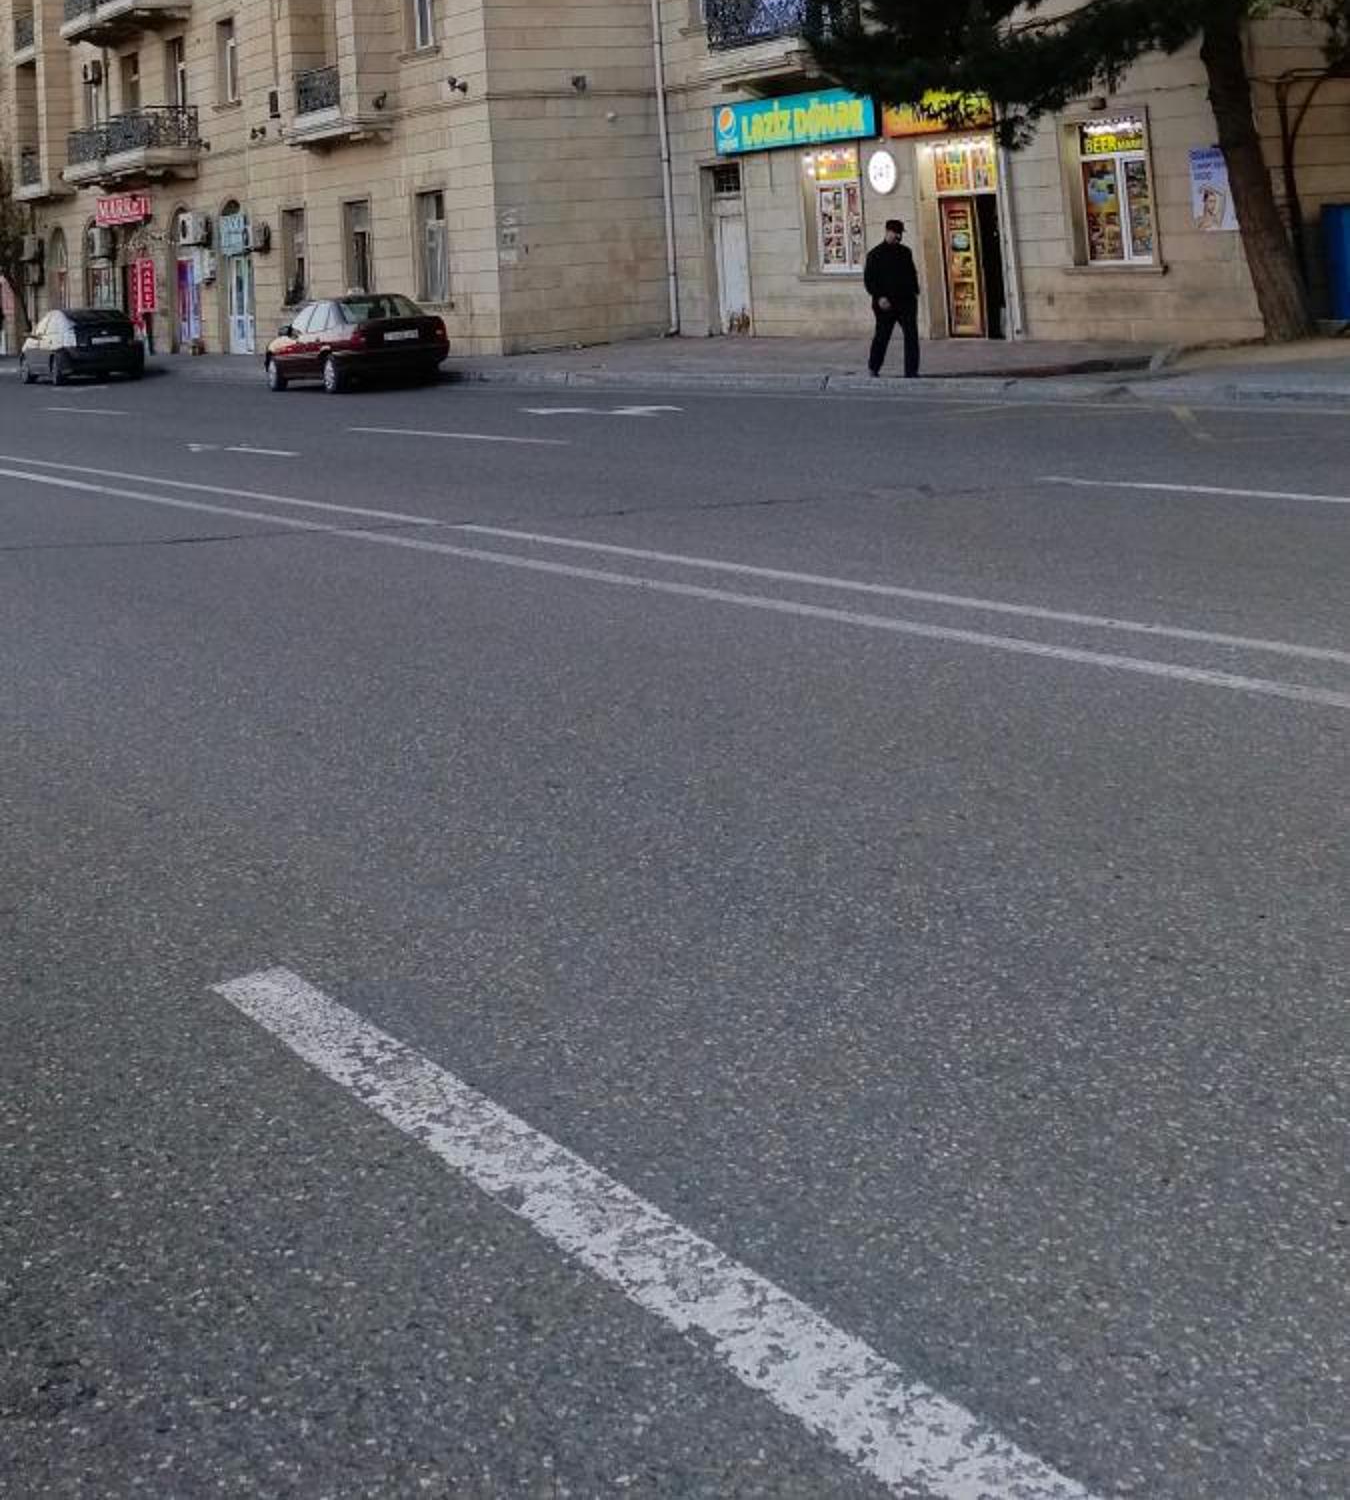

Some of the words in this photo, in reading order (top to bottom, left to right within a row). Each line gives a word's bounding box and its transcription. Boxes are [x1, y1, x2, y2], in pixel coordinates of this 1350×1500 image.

[1085, 134, 1116, 153] BEER
[98, 197, 149, 217] MARKET
[143, 261, 153, 309] MARKET
